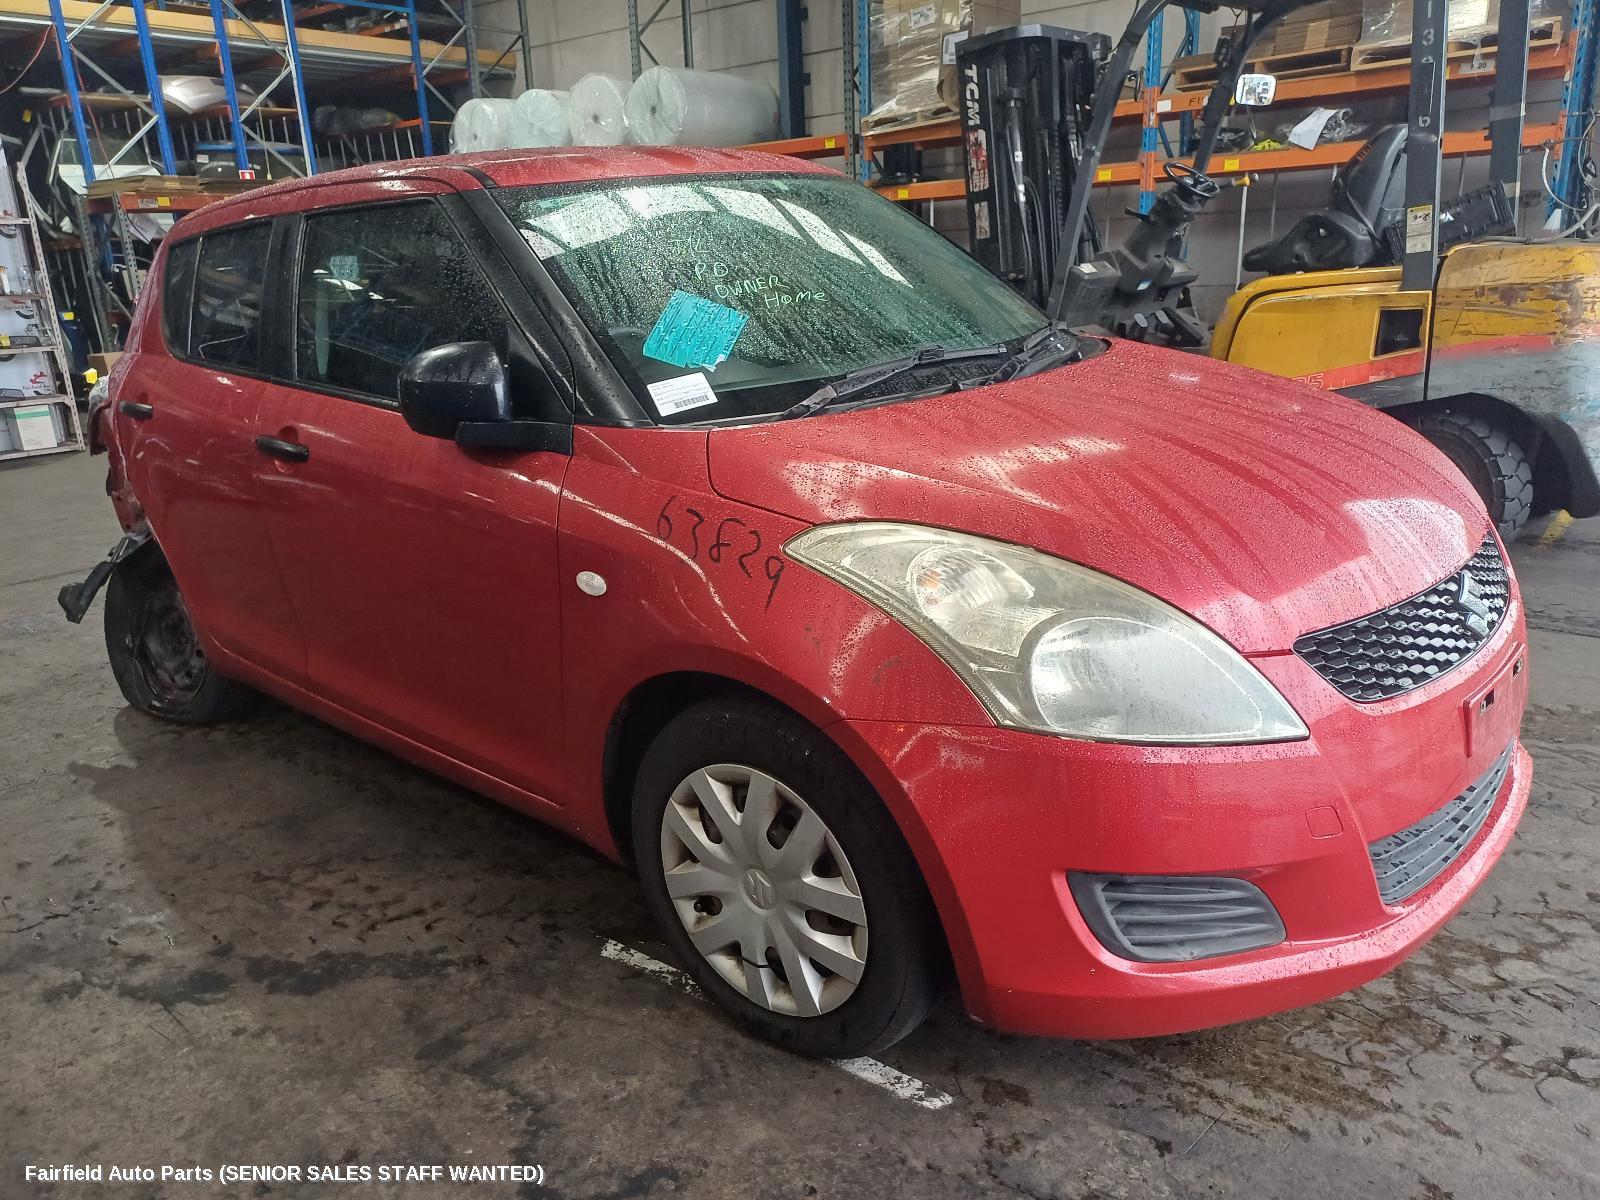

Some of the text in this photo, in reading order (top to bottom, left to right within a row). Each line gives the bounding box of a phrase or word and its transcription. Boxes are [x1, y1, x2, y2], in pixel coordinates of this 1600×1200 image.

[964, 63, 981, 127] TCM
[714, 275, 791, 299] OWNER
[764, 290, 828, 310] Home
